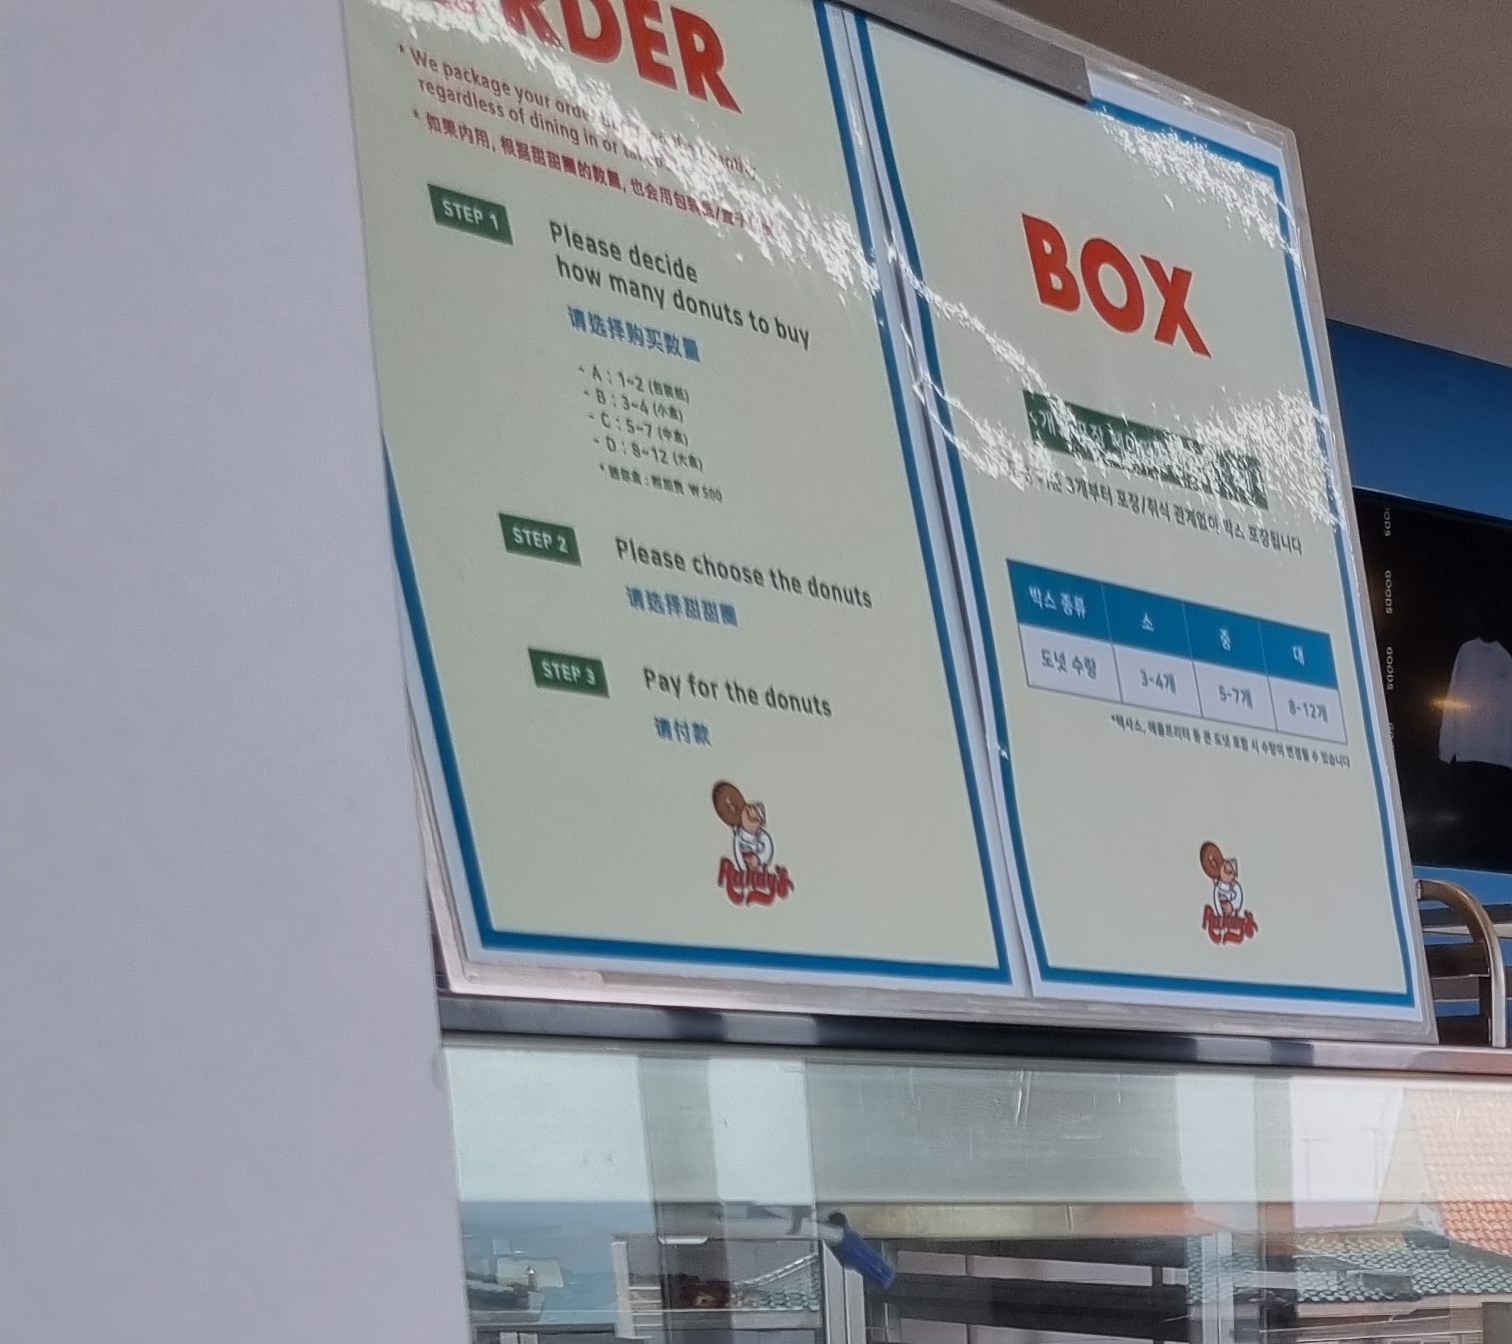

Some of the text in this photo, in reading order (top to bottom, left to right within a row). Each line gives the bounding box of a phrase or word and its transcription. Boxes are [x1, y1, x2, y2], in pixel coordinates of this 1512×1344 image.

[410, 48, 438, 73] We
[443, 62, 512, 97] package
[515, 84, 551, 110] your
[418, 79, 506, 118] regardless
[508, 108, 527, 126] of
[529, 111, 581, 147] dining
[584, 131, 600, 149] in
[602, 137, 618, 152] or
[442, 199, 500, 232] STEP 1
[549, 221, 699, 284] Please decide
[1021, 212, 1213, 359] BOX
[556, 255, 811, 352] how many donuts to buy
[567, 305, 701, 364] 请选择购买数量
[592, 366, 603, 382] A
[596, 388, 607, 405] B
[600, 412, 611, 429] C
[605, 435, 617, 453] D
[512, 526, 569, 554] STEP 2
[1248, 524, 1303, 556] 포장됩니다
[615, 536, 873, 610] Please choose the donuts
[1028, 584, 1087, 619] 박스 종류
[1141, 613, 1155, 633] 소
[1039, 647, 1098, 681] 도넛 수량
[1291, 644, 1306, 667] 대
[540, 659, 597, 686] STEP 3
[643, 666, 833, 718] Pay for the donuts
